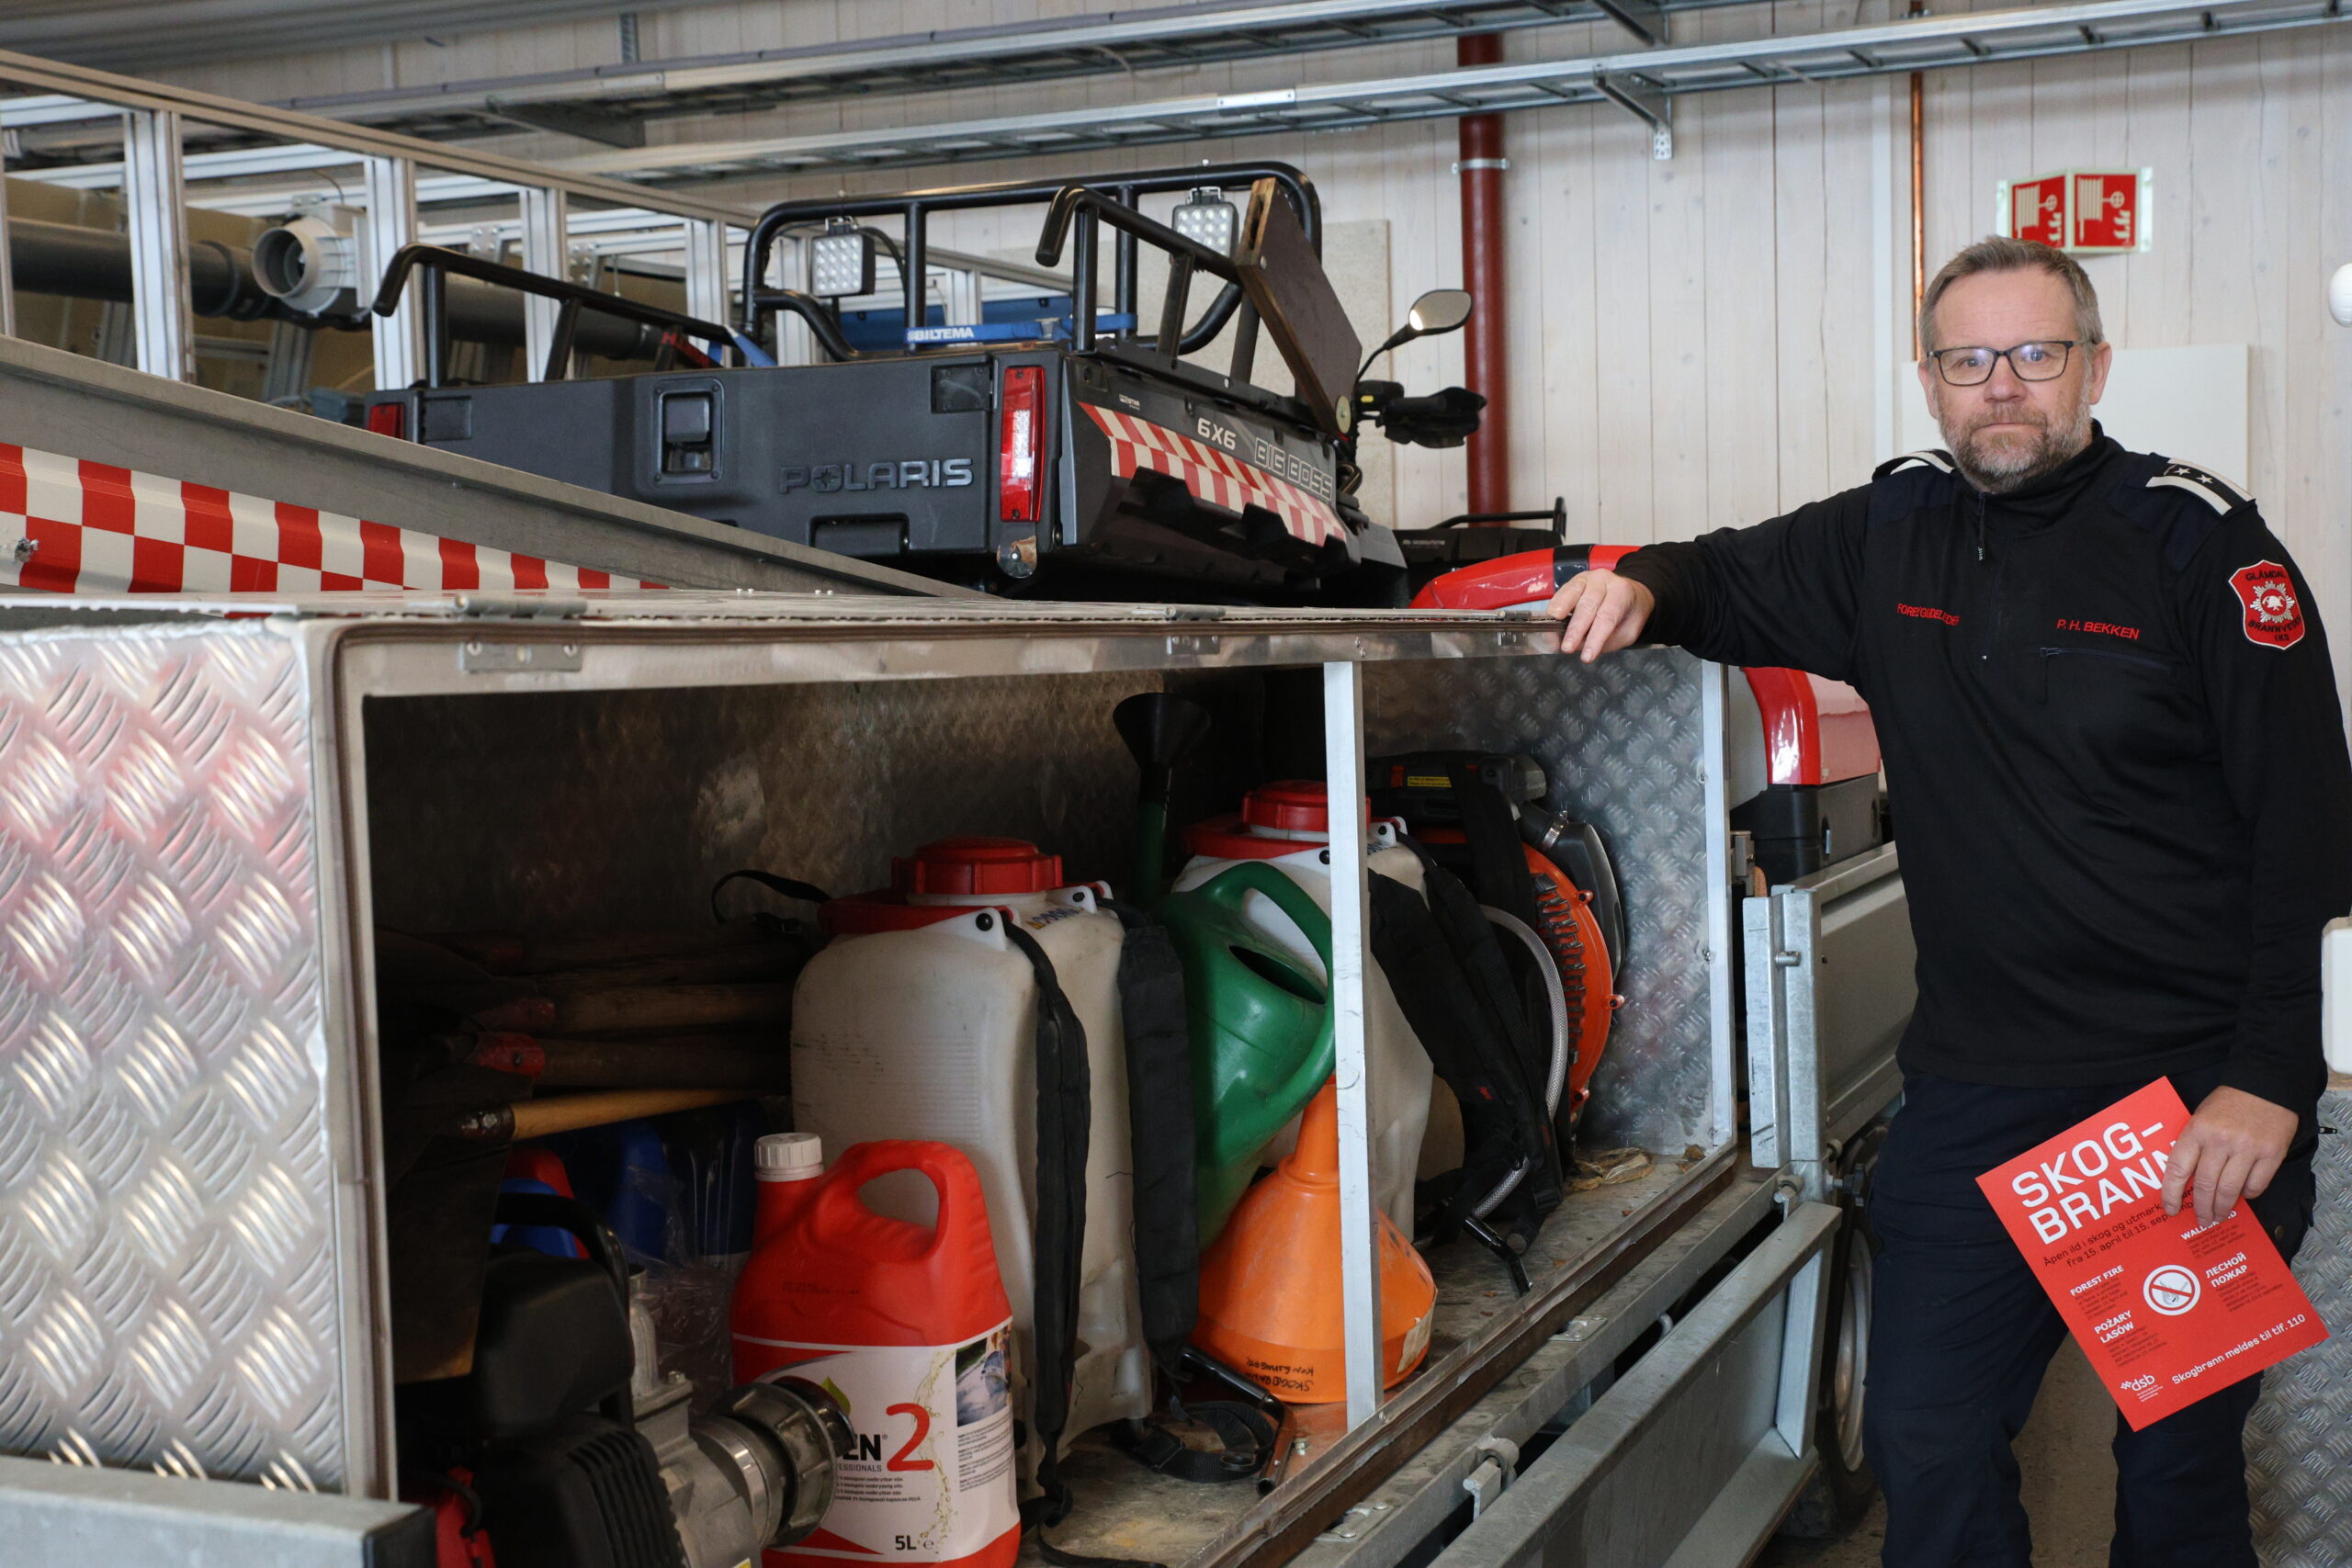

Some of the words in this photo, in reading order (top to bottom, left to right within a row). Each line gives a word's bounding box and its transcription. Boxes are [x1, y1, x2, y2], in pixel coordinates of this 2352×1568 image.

[916, 326, 975, 341] BILTEMA
[1197, 417, 1237, 451] 6X6
[779, 458, 973, 494] POLARIS
[1254, 437, 1285, 477] BIG
[1287, 454, 1333, 501] BOSS
[2056, 618, 2066, 630] P.
[2069, 619, 2081, 630] H.
[2084, 621, 2140, 640] BEKKEN
[2011, 1122, 2164, 1208] SKOG-
[2043, 1250, 2069, 1268] Åpen
[2069, 1242, 2082, 1255] ild
[2087, 1229, 2112, 1246] skog
[2112, 1222, 2126, 1234] og
[2126, 1203, 2164, 1224] utmark
[2067, 1256, 2084, 1268] fra
[2100, 1236, 2121, 1252] april
[2121, 1229, 2134, 1240] til
[2134, 1221, 2149, 1235] 15.
[2070, 1275, 2102, 1296] FOREST
[2103, 1264, 2124, 1280] FIRE
[2205, 1251, 2247, 1279] ЛЕСНОЙ
[2211, 1265, 2248, 1288] ПОЖАР
[2094, 1310, 2132, 1335] POŻARY
[2099, 1321, 2134, 1343] LASÓW
[2171, 1355, 2225, 1384] Skogbrann
[2224, 1337, 2260, 1359] meldes
[2259, 1329, 2272, 1342] til
[2271, 1322, 2289, 1337] tlf.
[2288, 1314, 2306, 1329] 110
[2131, 1373, 2155, 1392] dsb
[886, 1403, 934, 1472] 2
[838, 1462, 882, 1473] ESSIONALS
[895, 1535, 917, 1551] 5L
